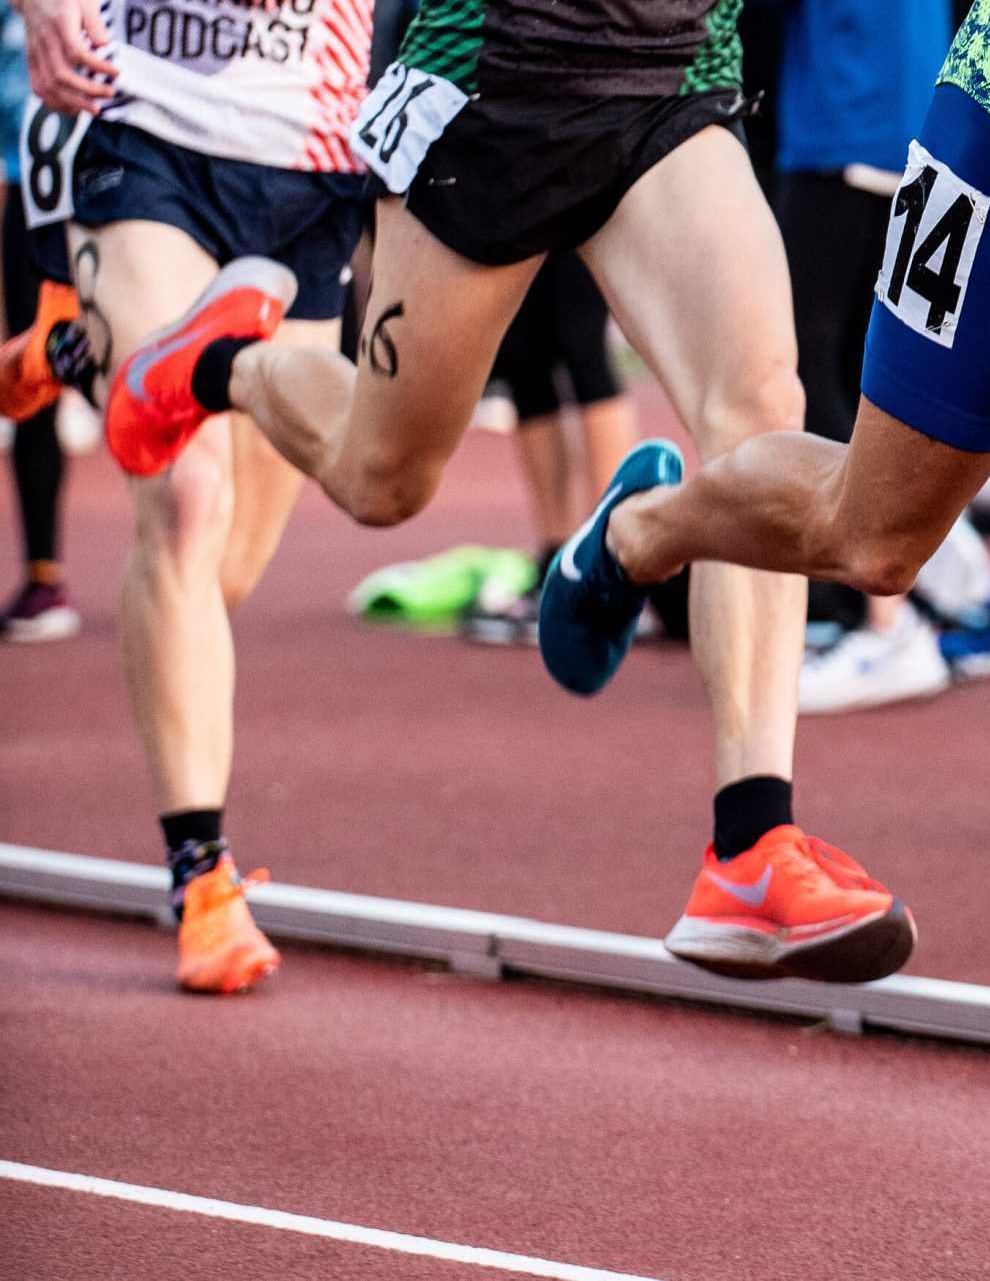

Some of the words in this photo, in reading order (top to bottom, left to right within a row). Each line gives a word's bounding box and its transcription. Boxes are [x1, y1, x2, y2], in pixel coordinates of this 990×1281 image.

[126, 5, 311, 63] PODCAST
[27, 105, 79, 212] 8
[358, 63, 436, 165] 26
[887, 164, 976, 336] 14
